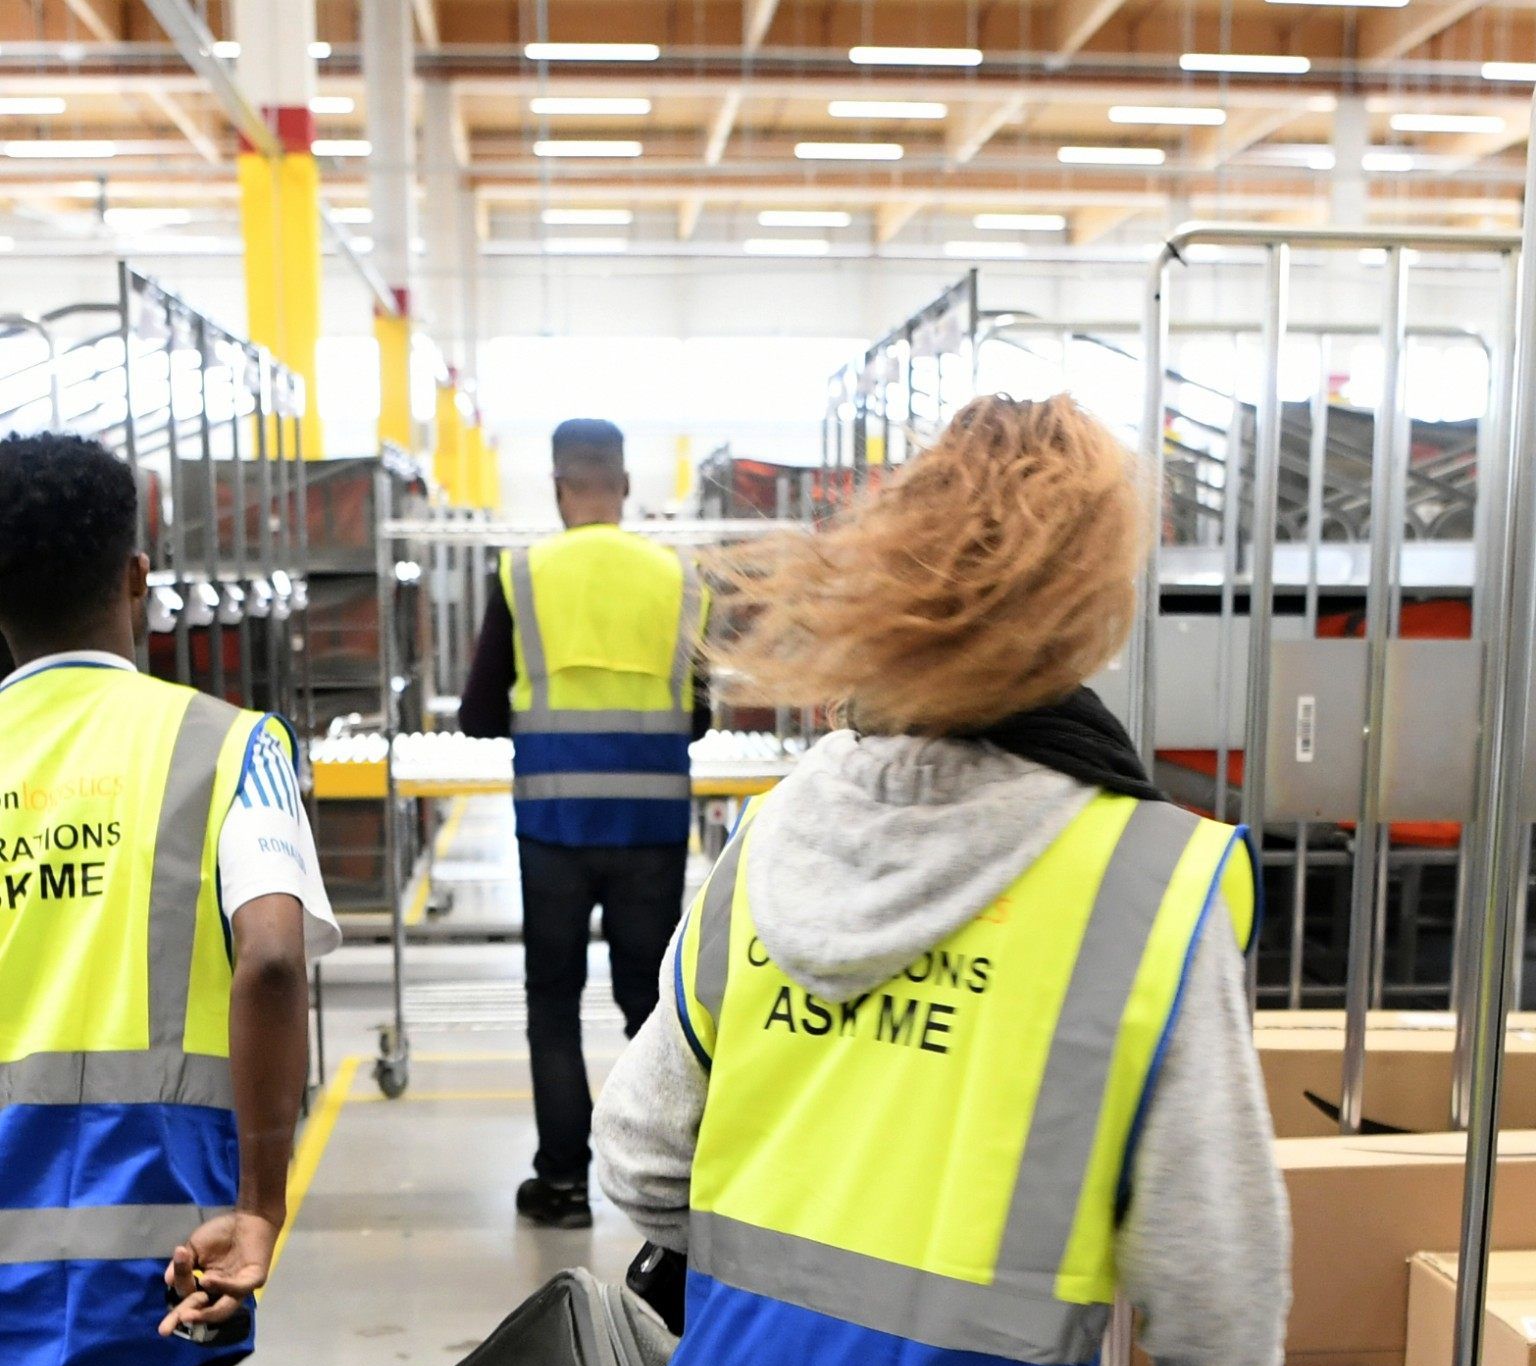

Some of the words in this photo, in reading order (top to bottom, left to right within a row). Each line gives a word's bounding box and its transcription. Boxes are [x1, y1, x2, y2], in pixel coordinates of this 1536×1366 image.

[0, 872, 33, 910] K
[40, 862, 105, 900] ME
[764, 986, 870, 1036] ASK
[876, 994, 956, 1055] ME
